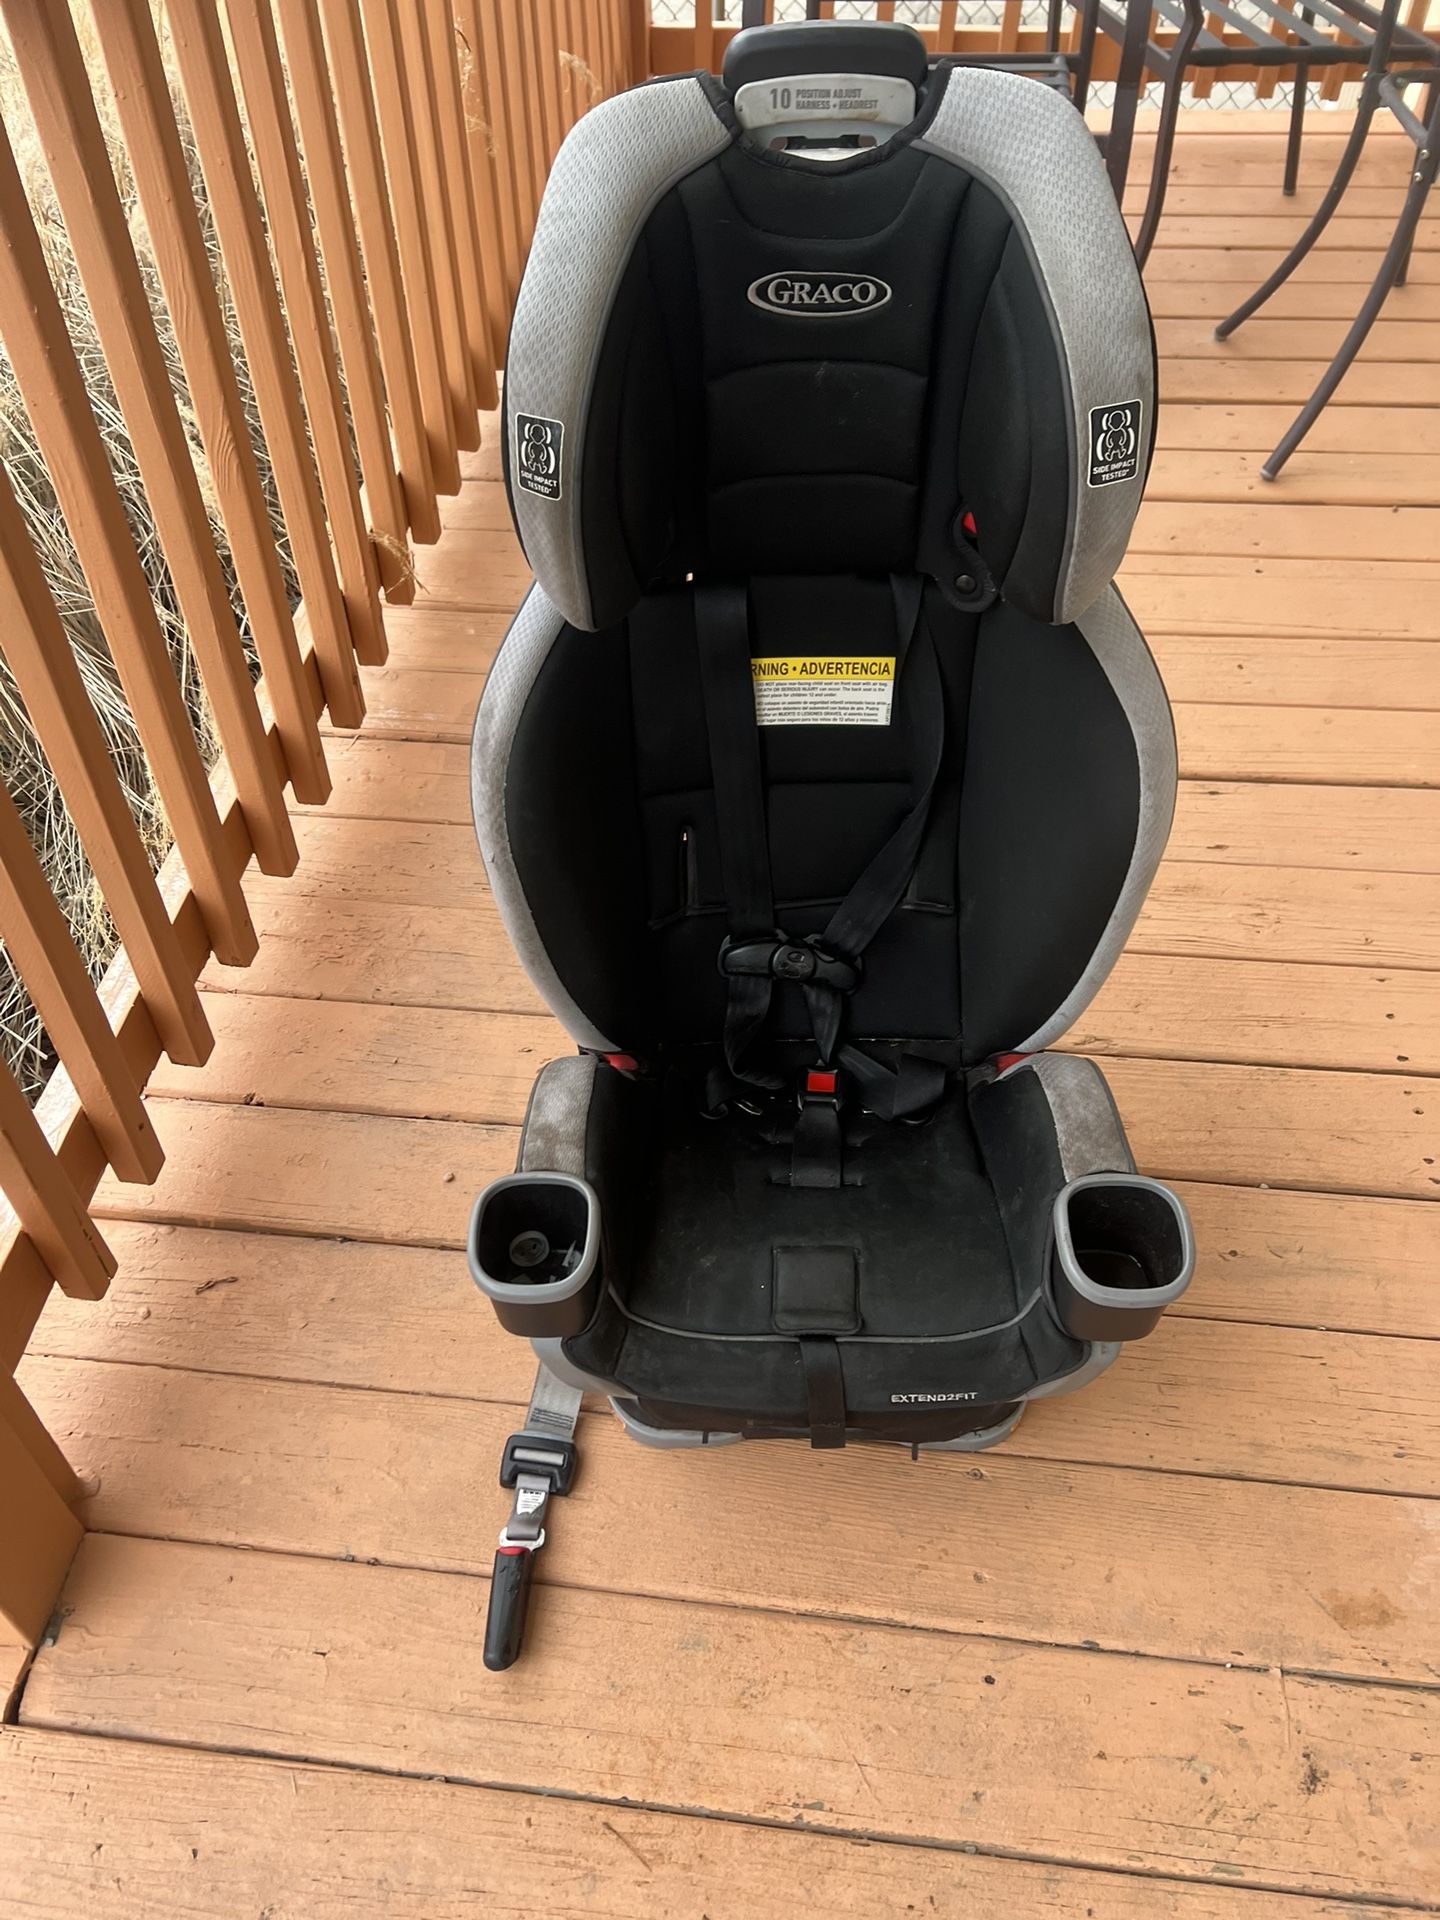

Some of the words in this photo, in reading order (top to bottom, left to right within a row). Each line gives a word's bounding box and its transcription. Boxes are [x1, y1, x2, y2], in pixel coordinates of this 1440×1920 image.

[770, 88, 791, 109] 10
[796, 89, 831, 98] POSITION
[833, 89, 862, 98] ADJUST
[796, 100, 830, 109] HARNESS
[839, 100, 878, 109] HEADREST
[768, 279, 877, 304] GRACO
[1093, 465, 1109, 474] SIDE
[1111, 459, 1135, 470] IMPACT
[521, 470, 532, 480] SIDE
[534, 475, 557, 487] IMPACT
[800, 662, 890, 675] ADVERTENCIA
[891, 1392, 978, 1403] EXTEND2FIT
